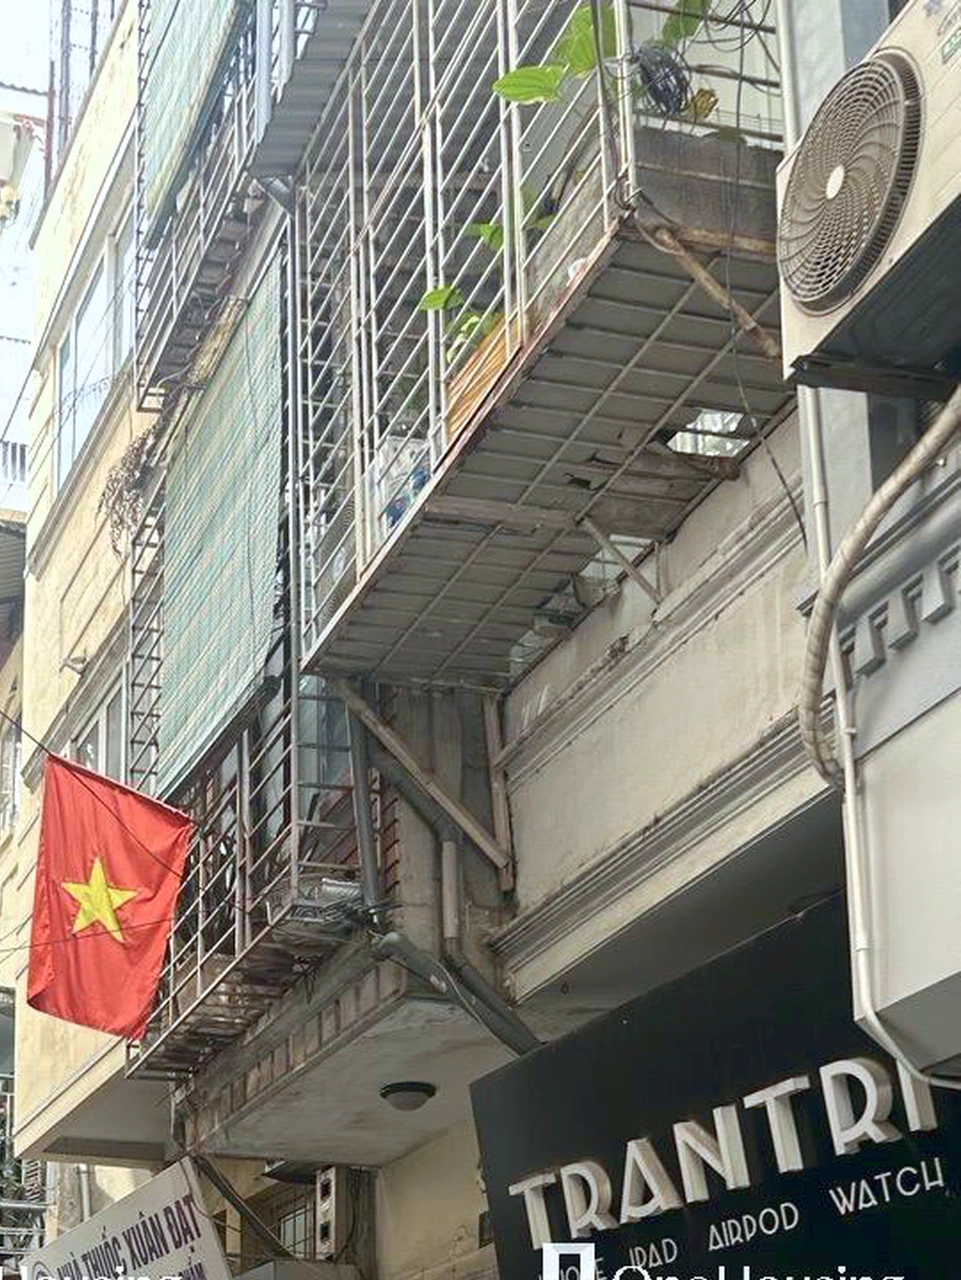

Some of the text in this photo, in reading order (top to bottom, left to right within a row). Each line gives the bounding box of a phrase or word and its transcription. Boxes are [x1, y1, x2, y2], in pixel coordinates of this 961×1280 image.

[122, 1211, 170, 1271] XUÂN
[707, 1201, 799, 1252] AIRPOD
[829, 1157, 944, 1216] WATCH
